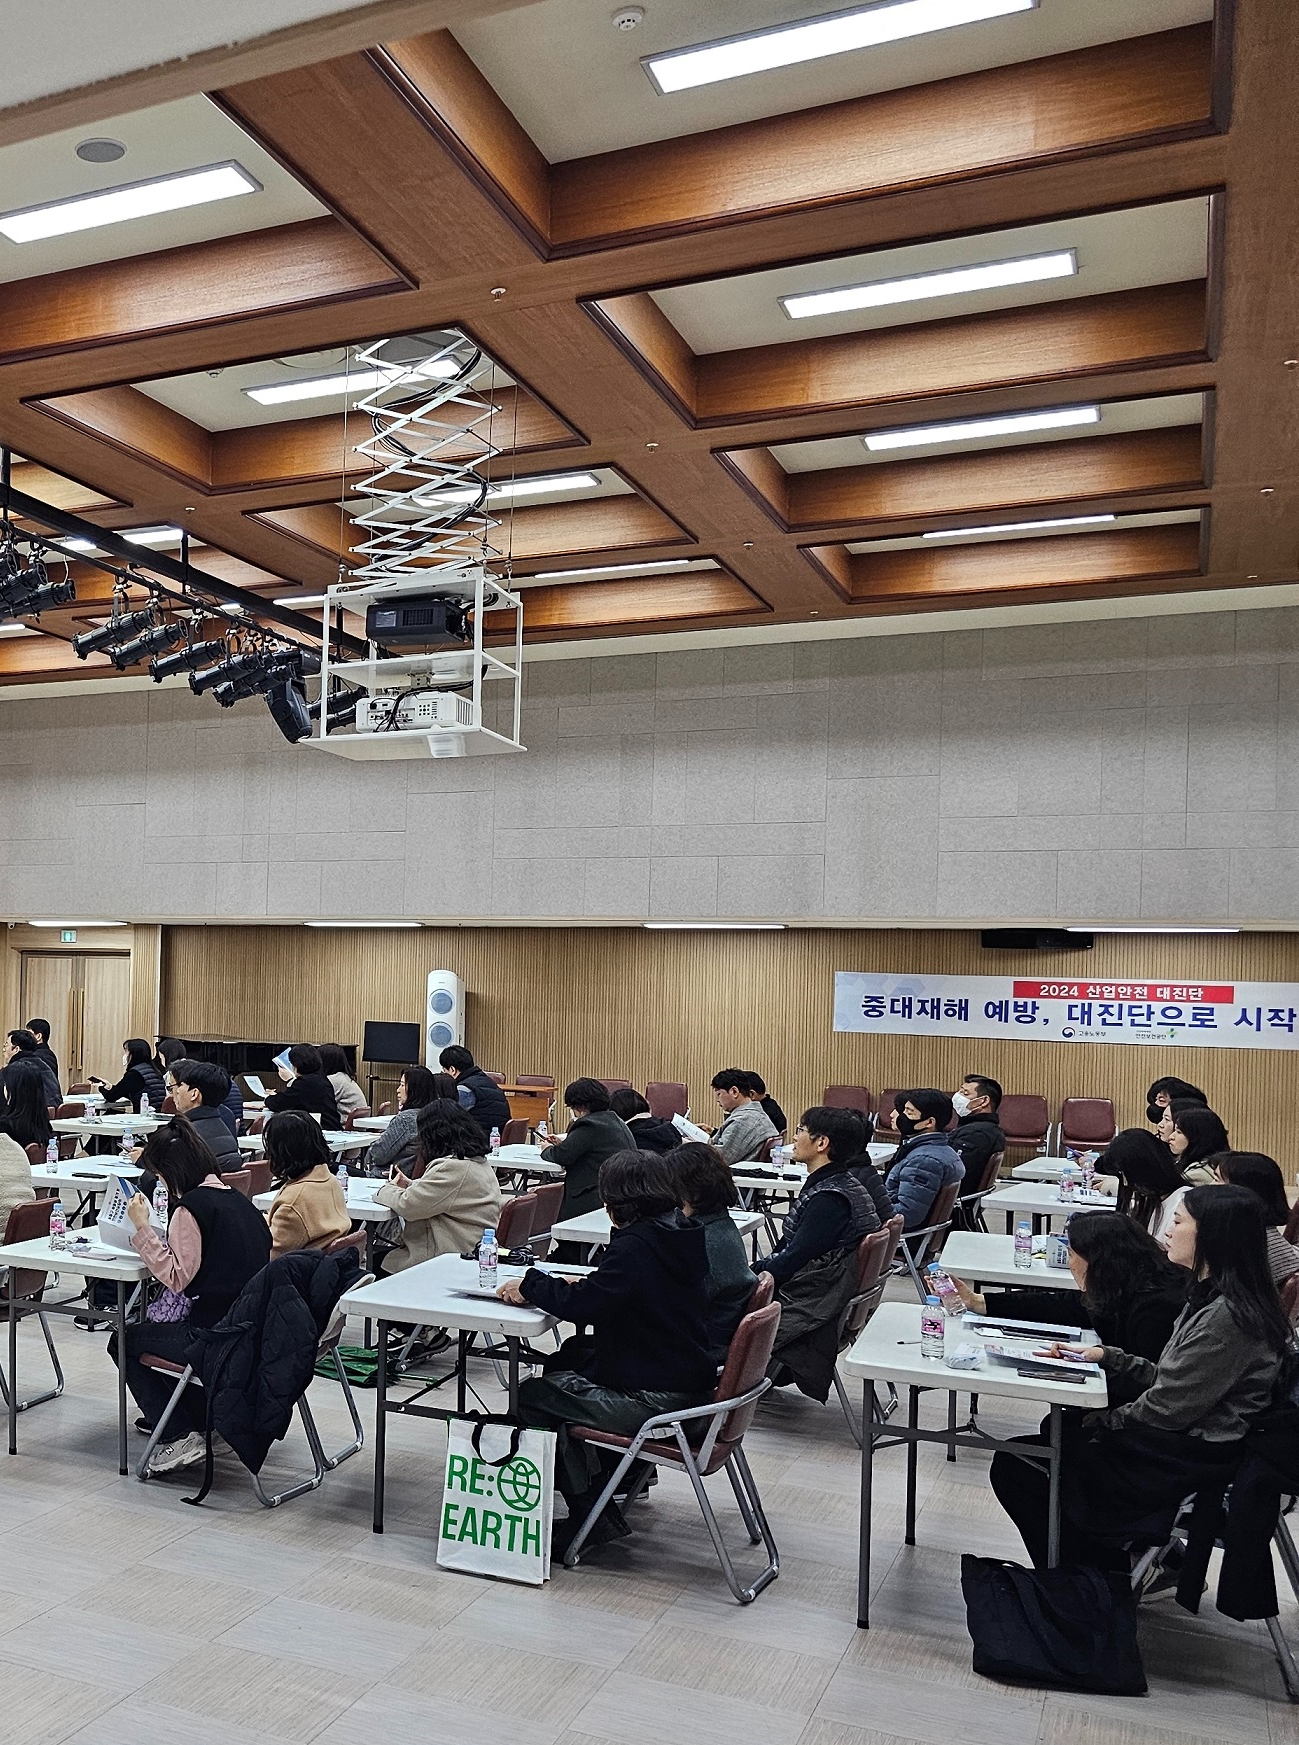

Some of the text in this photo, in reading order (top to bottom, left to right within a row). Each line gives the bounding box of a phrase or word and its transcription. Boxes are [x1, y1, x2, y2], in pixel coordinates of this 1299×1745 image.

[1040, 985, 1204, 1001] 2024 산업안전 대진단
[861, 995, 1297, 1033] 중대재해 예방, 대진단으로 시작
[448, 1454, 494, 1497] RE:
[442, 1503, 540, 1557] EARTH
